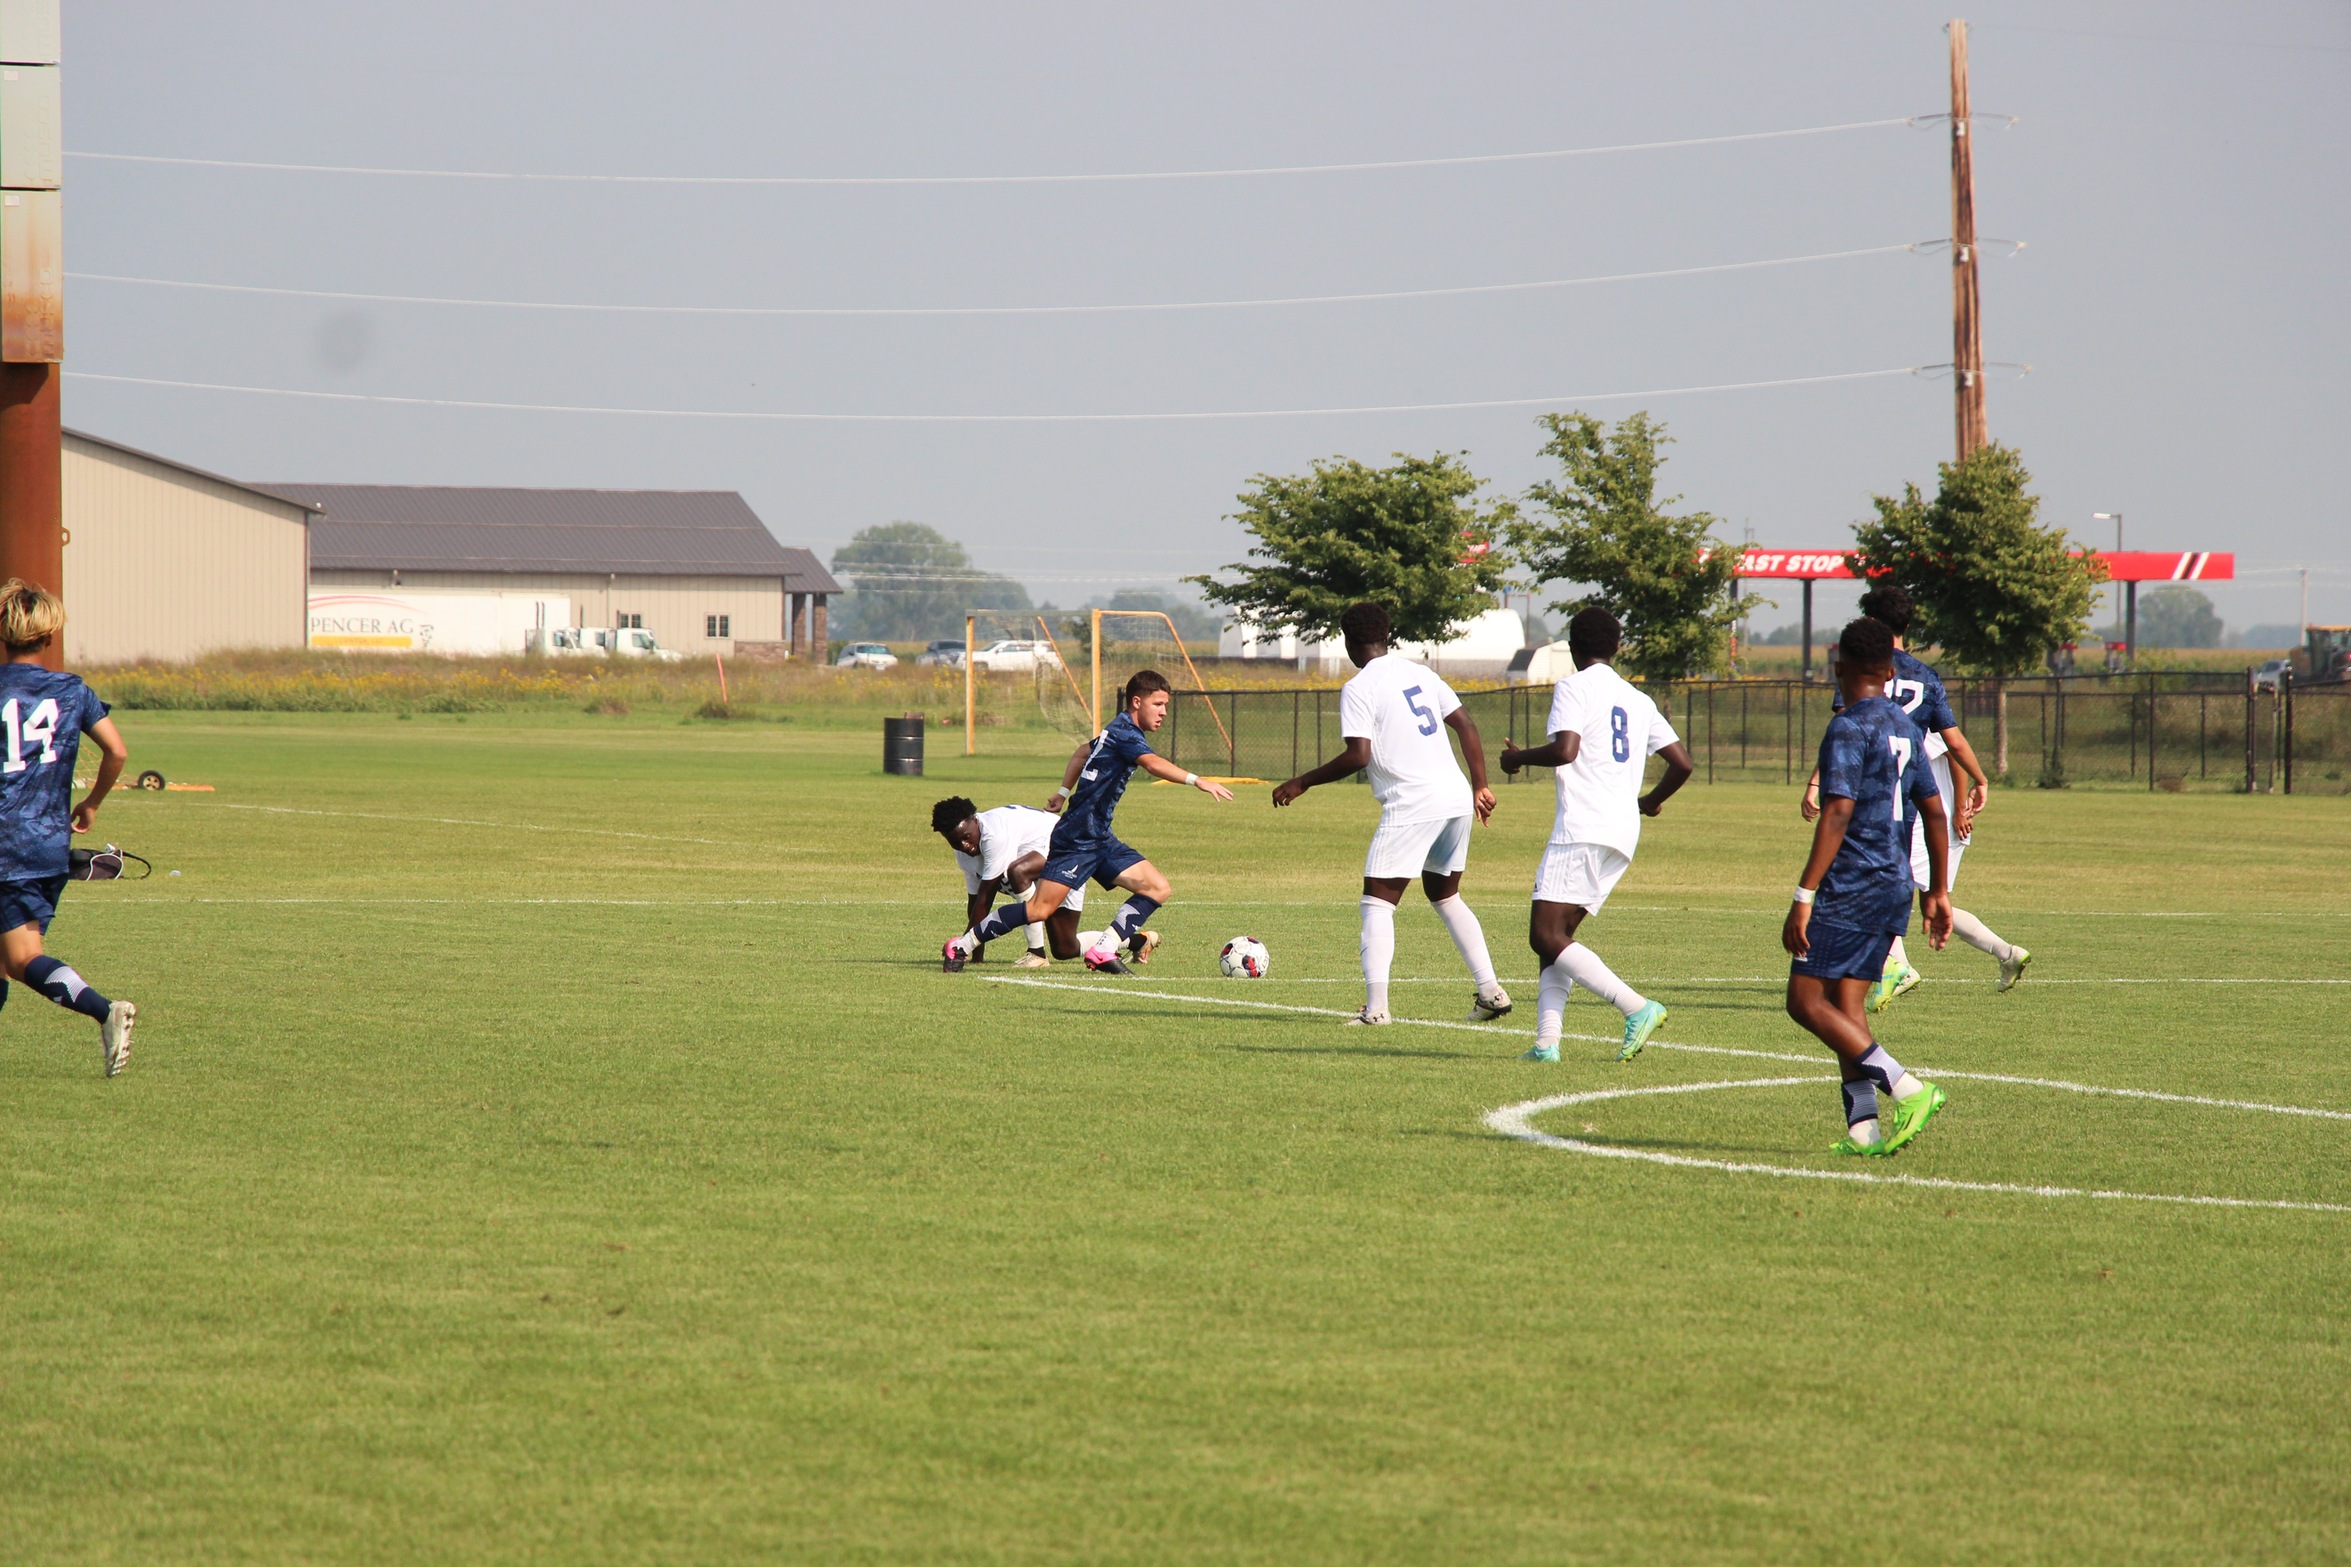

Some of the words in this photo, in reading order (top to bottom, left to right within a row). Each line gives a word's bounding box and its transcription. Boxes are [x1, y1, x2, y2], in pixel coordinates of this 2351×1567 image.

[1786, 555, 1845, 573] STOP
[387, 617, 413, 634] AG
[2, 698, 59, 773] 14
[1402, 685, 1438, 736] 5
[1611, 706, 1630, 763] 8
[1888, 735, 1911, 821] 7
